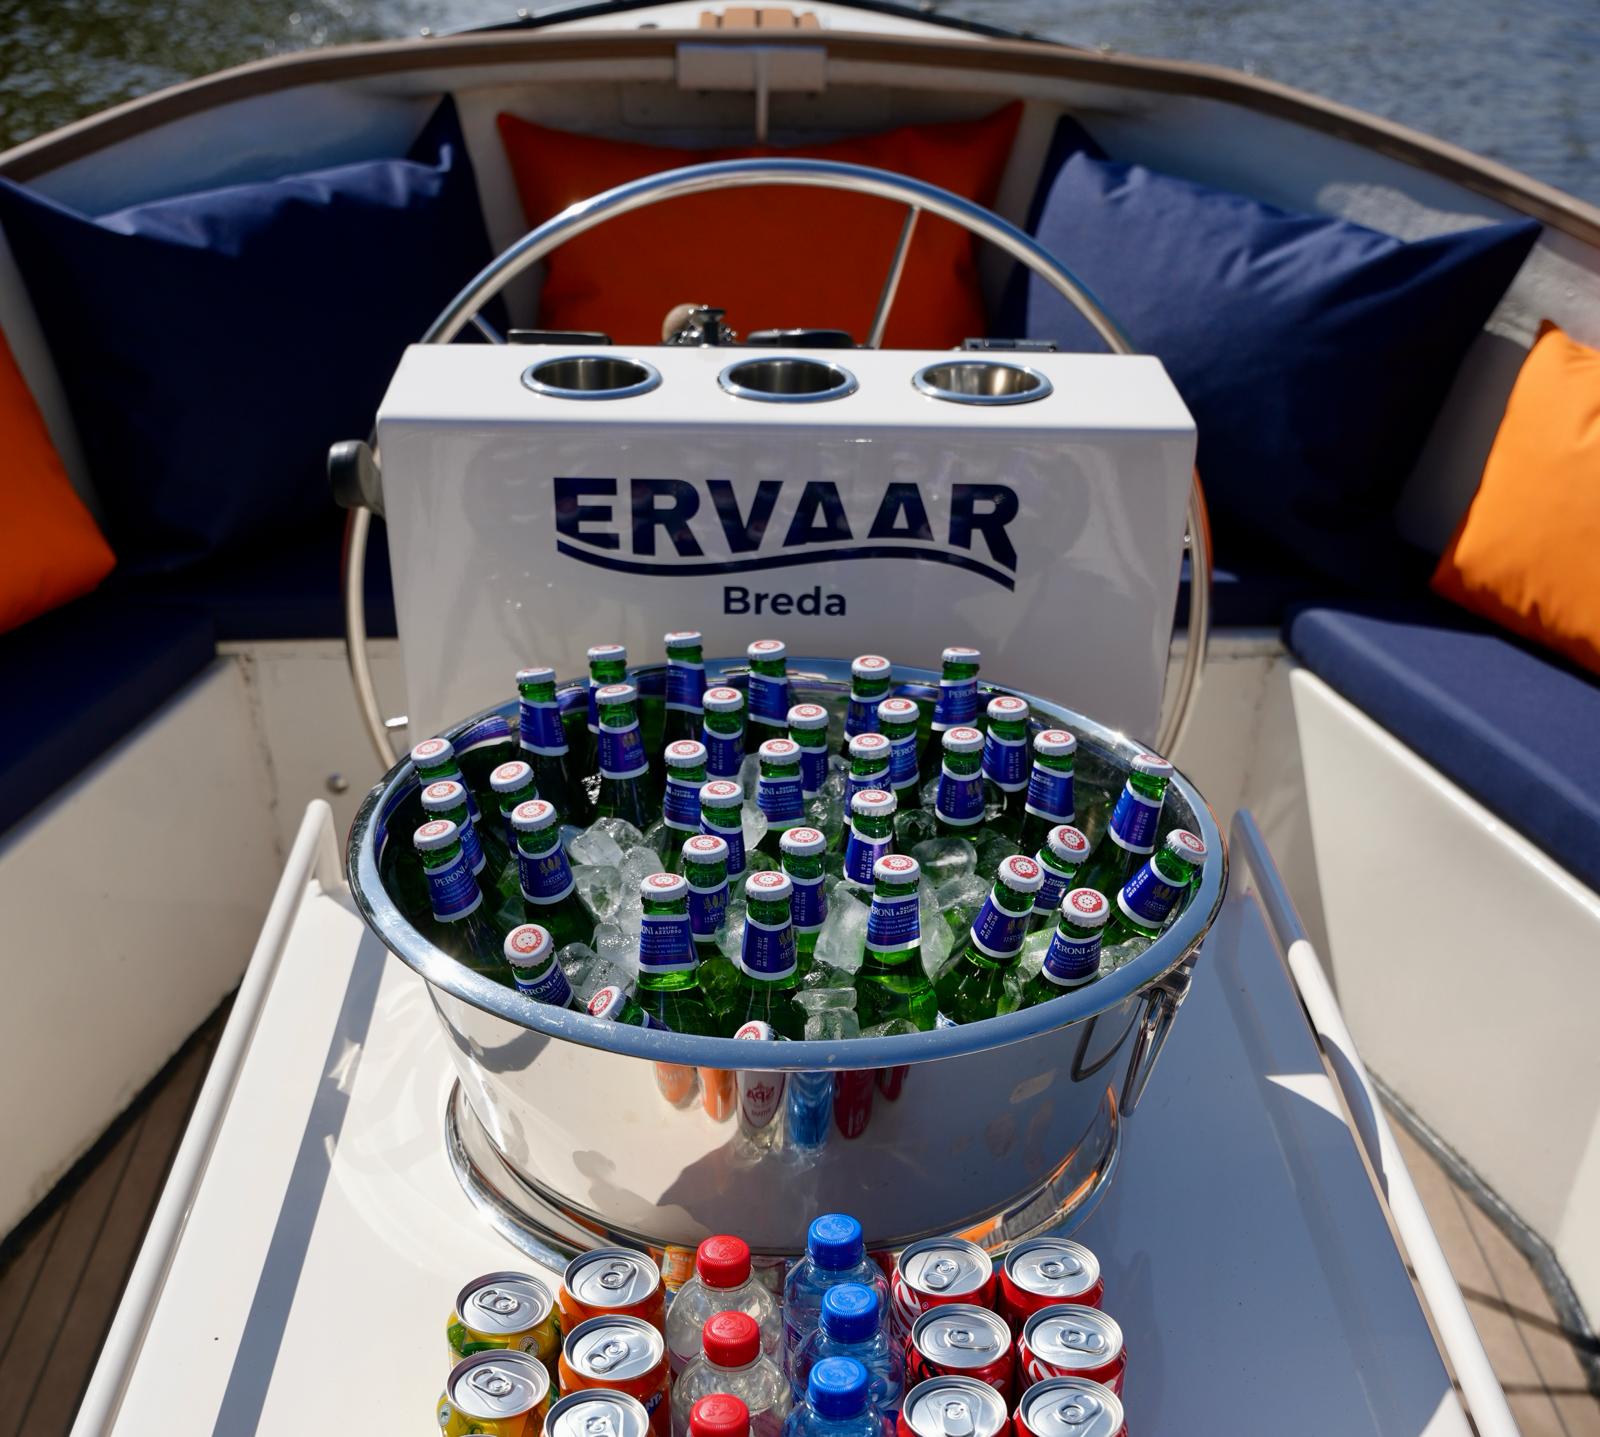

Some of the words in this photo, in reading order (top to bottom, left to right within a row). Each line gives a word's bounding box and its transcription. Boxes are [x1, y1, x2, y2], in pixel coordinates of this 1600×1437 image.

[553, 477, 1019, 573] ERVAAR
[723, 586, 847, 616] Breda
[434, 864, 466, 888] PERONI
[872, 906, 895, 917] ERONI
[1053, 938, 1086, 956] PERONI
[518, 980, 553, 996] PERONI
